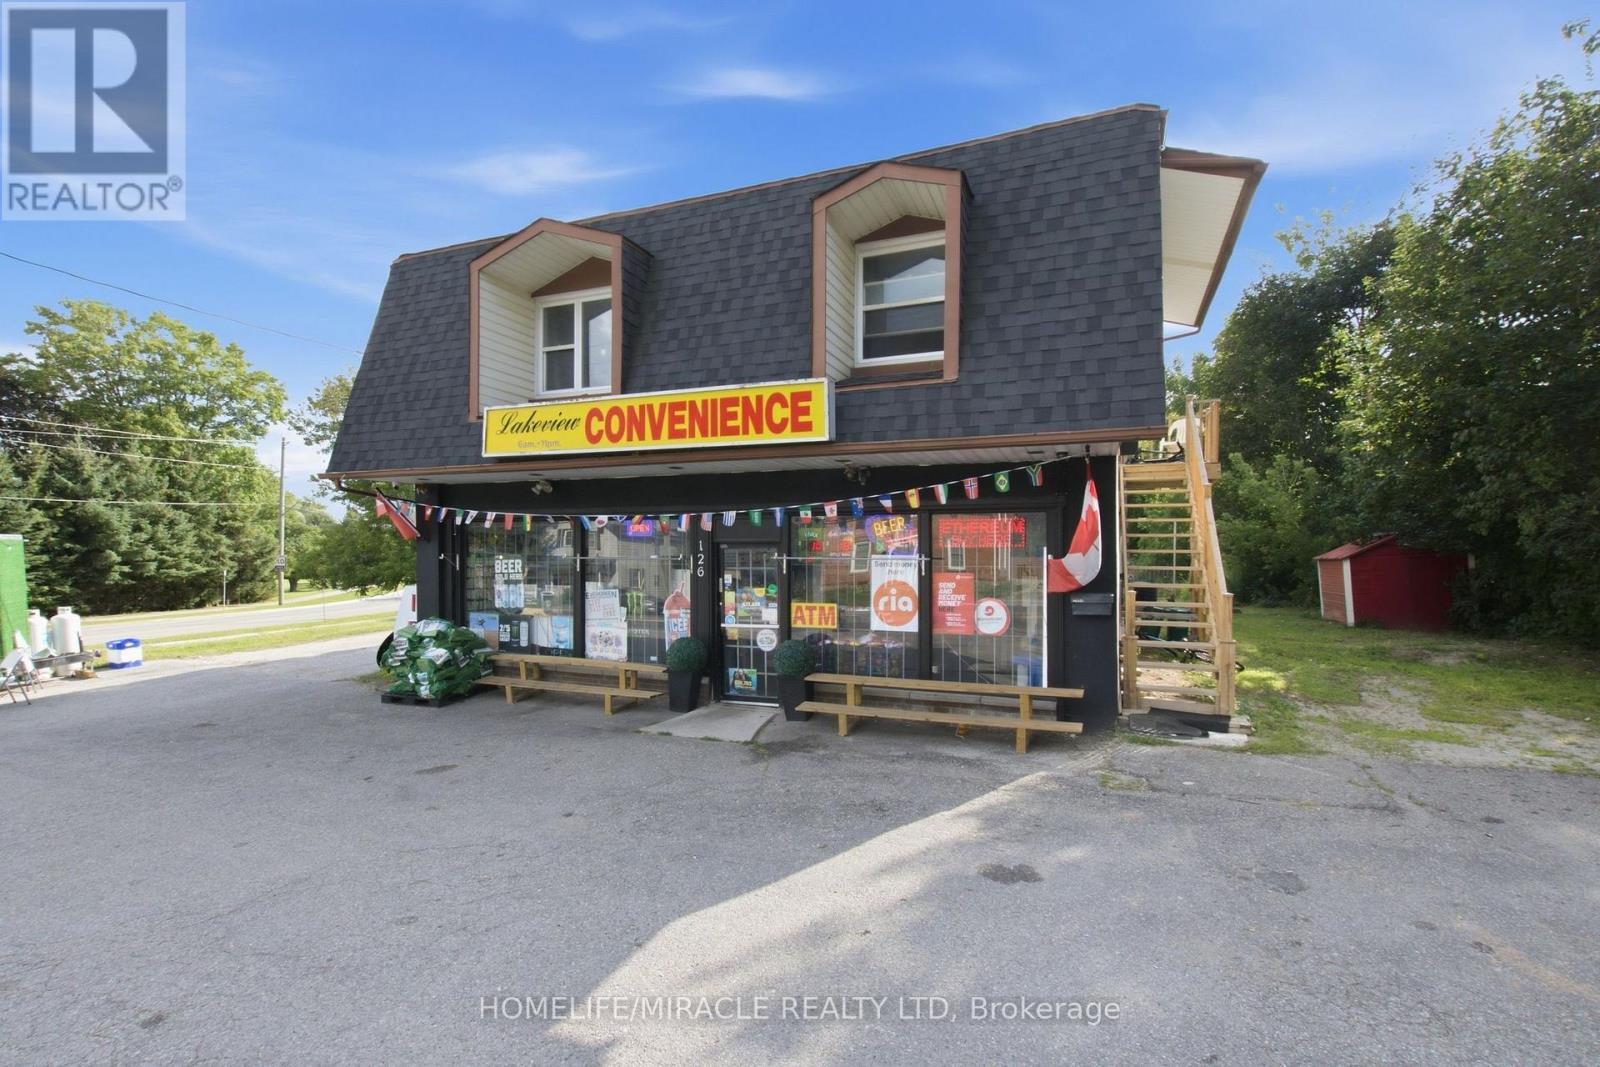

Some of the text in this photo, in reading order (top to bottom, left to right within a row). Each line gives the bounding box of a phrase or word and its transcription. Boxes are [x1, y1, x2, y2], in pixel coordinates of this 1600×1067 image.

[496, 390, 813, 445] Lakeview CONVENIENCE
[873, 516, 905, 537] BEER
[494, 559, 522, 573] BEER
[879, 587, 913, 612] ria
[792, 605, 836, 625] ATM
